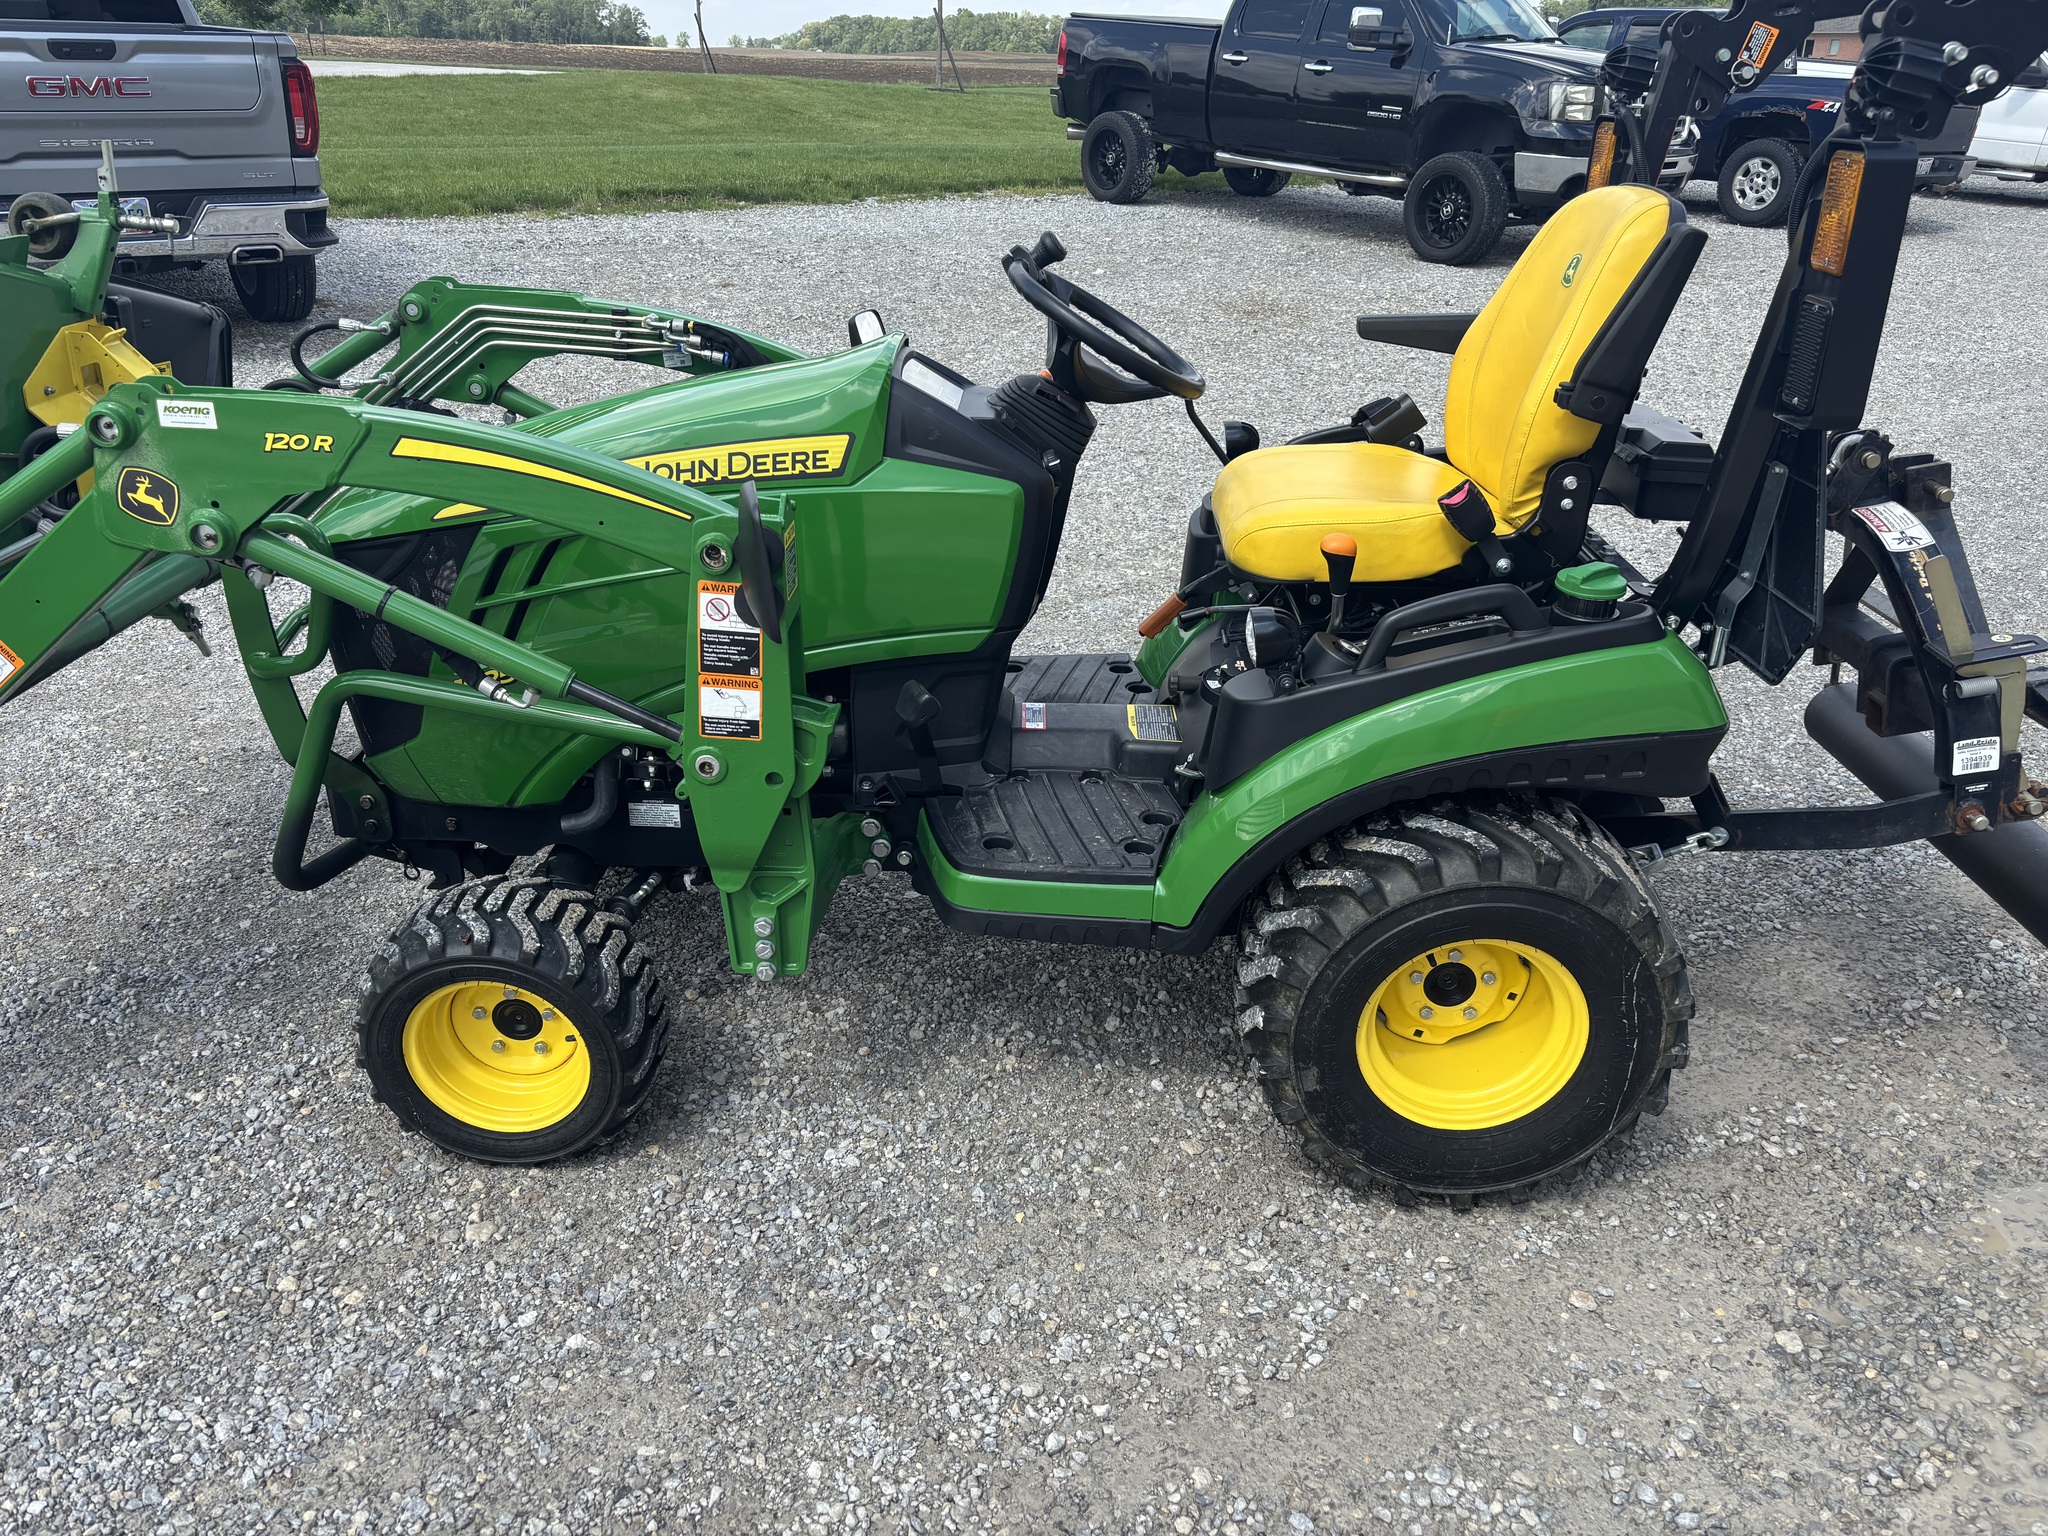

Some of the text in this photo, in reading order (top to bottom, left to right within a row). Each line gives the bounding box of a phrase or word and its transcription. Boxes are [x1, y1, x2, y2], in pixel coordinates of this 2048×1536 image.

[26, 75, 151, 98] GMC
[39, 138, 154, 148] SIERRA
[242, 171, 278, 179] SLT
[727, 449, 830, 477] DEERE
[711, 583, 741, 593] WARN
[0, 645, 17, 663] NING
[711, 678, 759, 689] WARNING
[1957, 738, 1997, 749] Land Pride
[1961, 754, 1993, 764] 1394939
